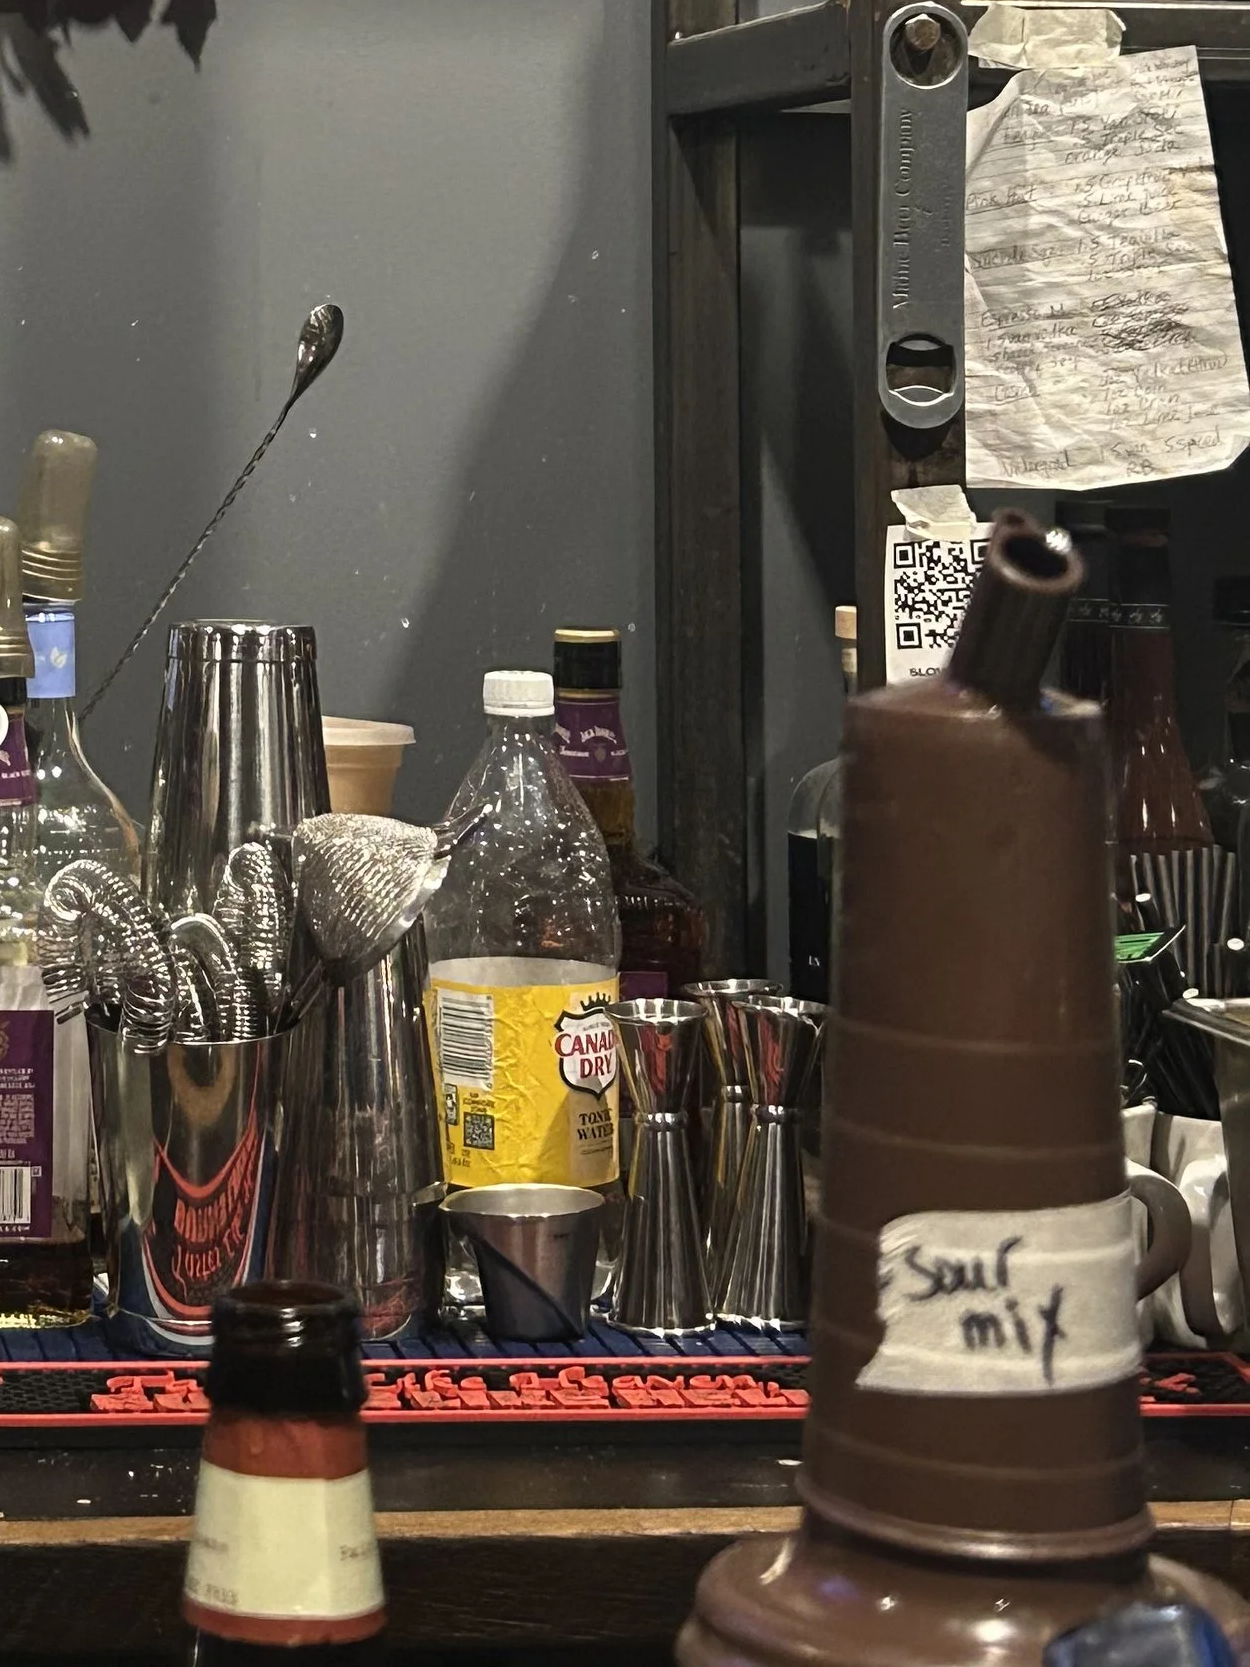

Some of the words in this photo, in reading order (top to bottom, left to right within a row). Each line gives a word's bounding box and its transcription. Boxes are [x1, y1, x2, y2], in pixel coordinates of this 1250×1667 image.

[579, 1053, 613, 1079] DRY
[903, 1235, 1023, 1302] Sour
[958, 1284, 1068, 1386] mix
